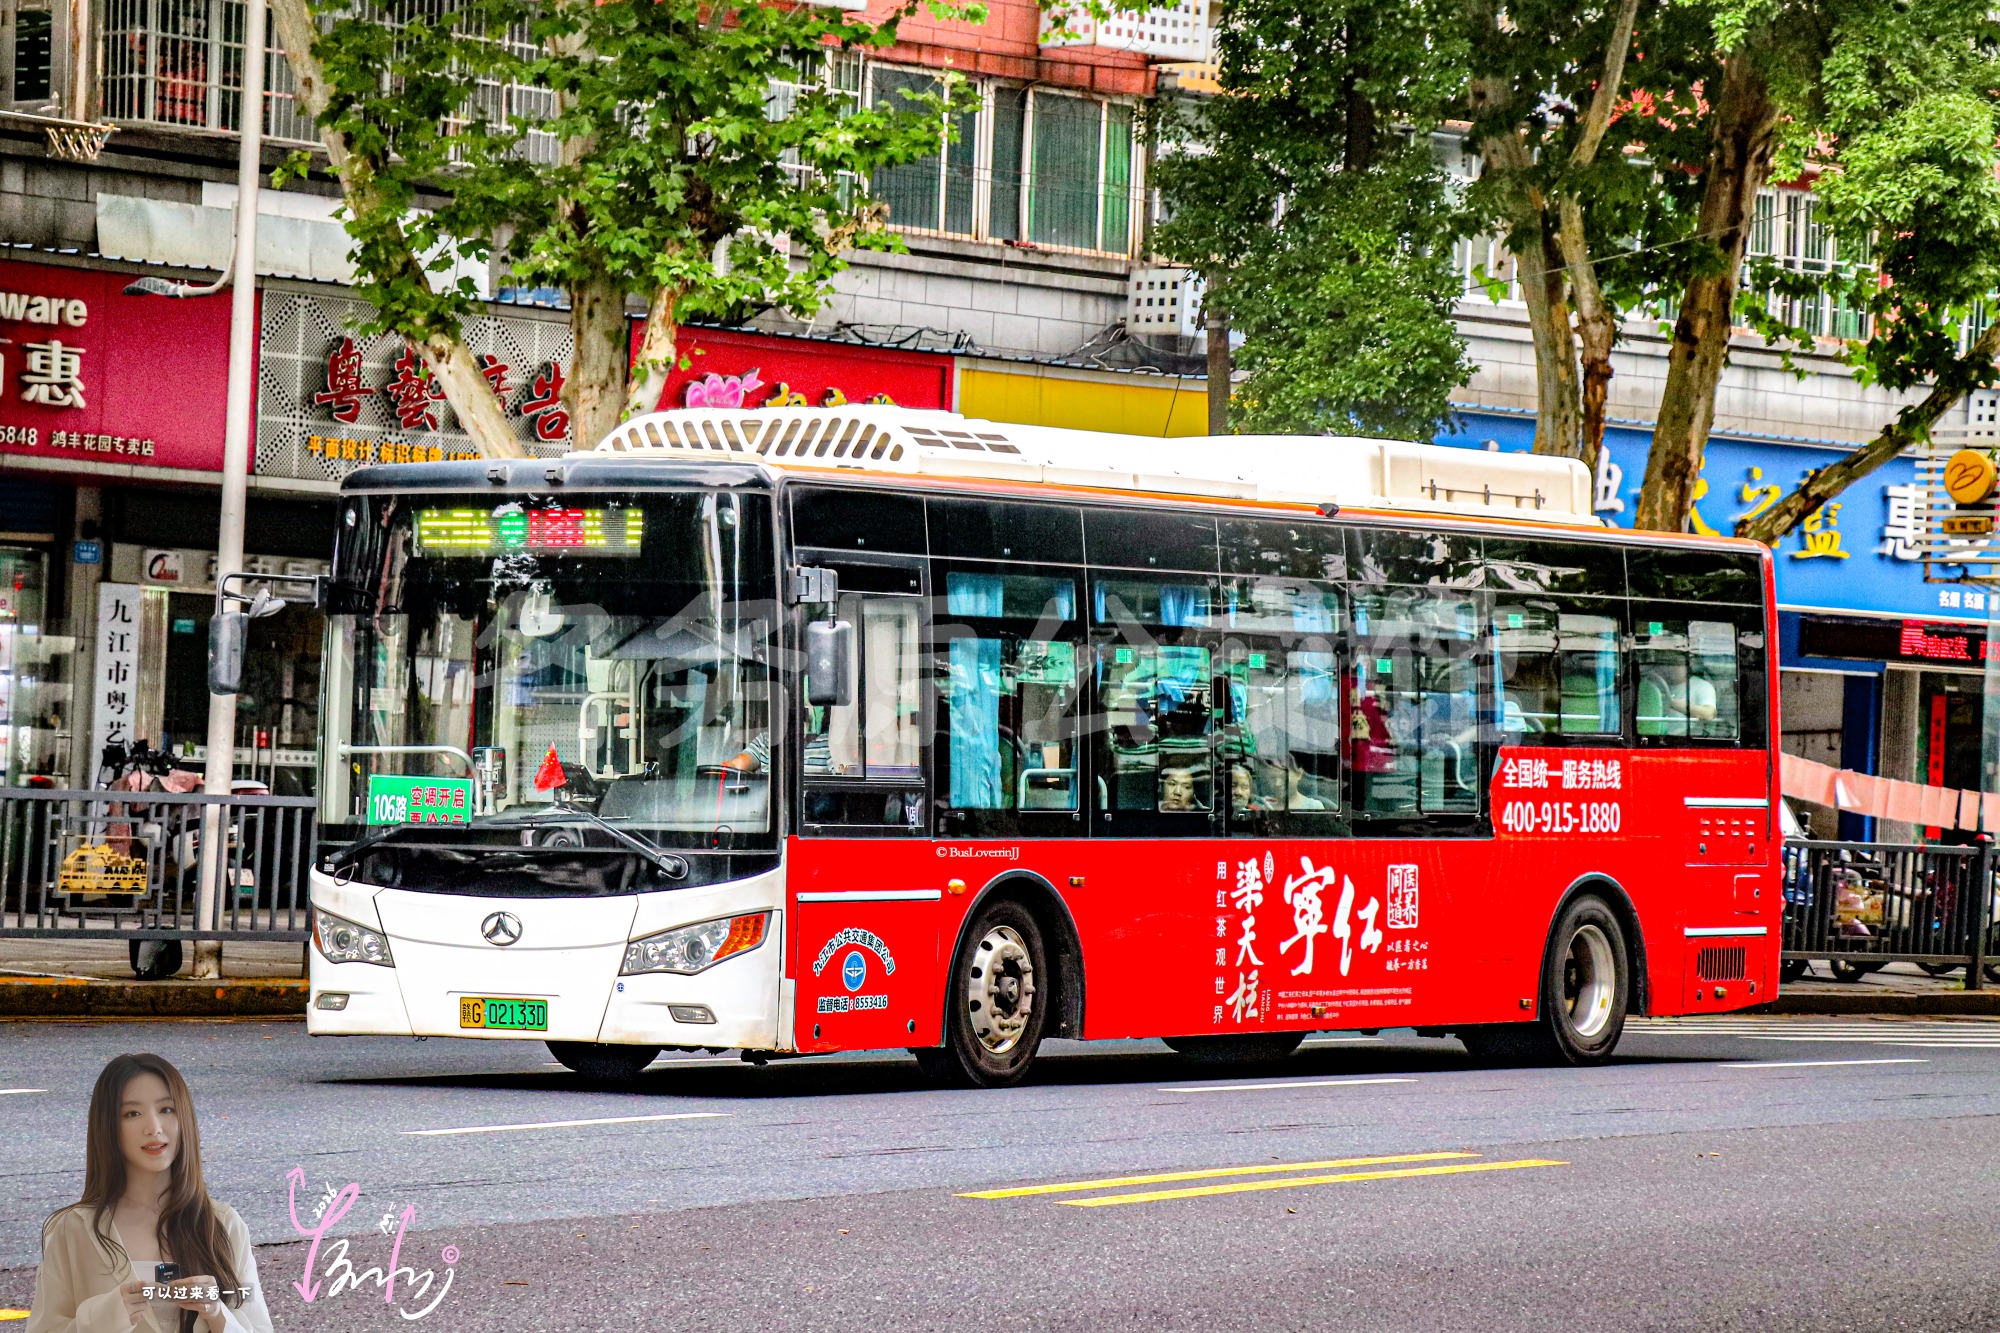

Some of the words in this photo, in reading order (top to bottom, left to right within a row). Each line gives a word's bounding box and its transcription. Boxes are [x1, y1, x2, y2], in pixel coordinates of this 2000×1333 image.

[0, 339, 87, 409] 惠
[51, 430, 156, 457] 鸿丰花园专卖店
[308, 435, 373, 461] 平面设计
[1502, 758, 1621, 789] 全国统一服务热线
[374, 794, 407, 822] 106路
[410, 786, 466, 808] 空调开启
[1502, 801, 1621, 833] 400-915-1880
[813, 927, 896, 976] 九江市公共交通集团公司
[1213, 861, 1227, 1024] 用红茶观世界
